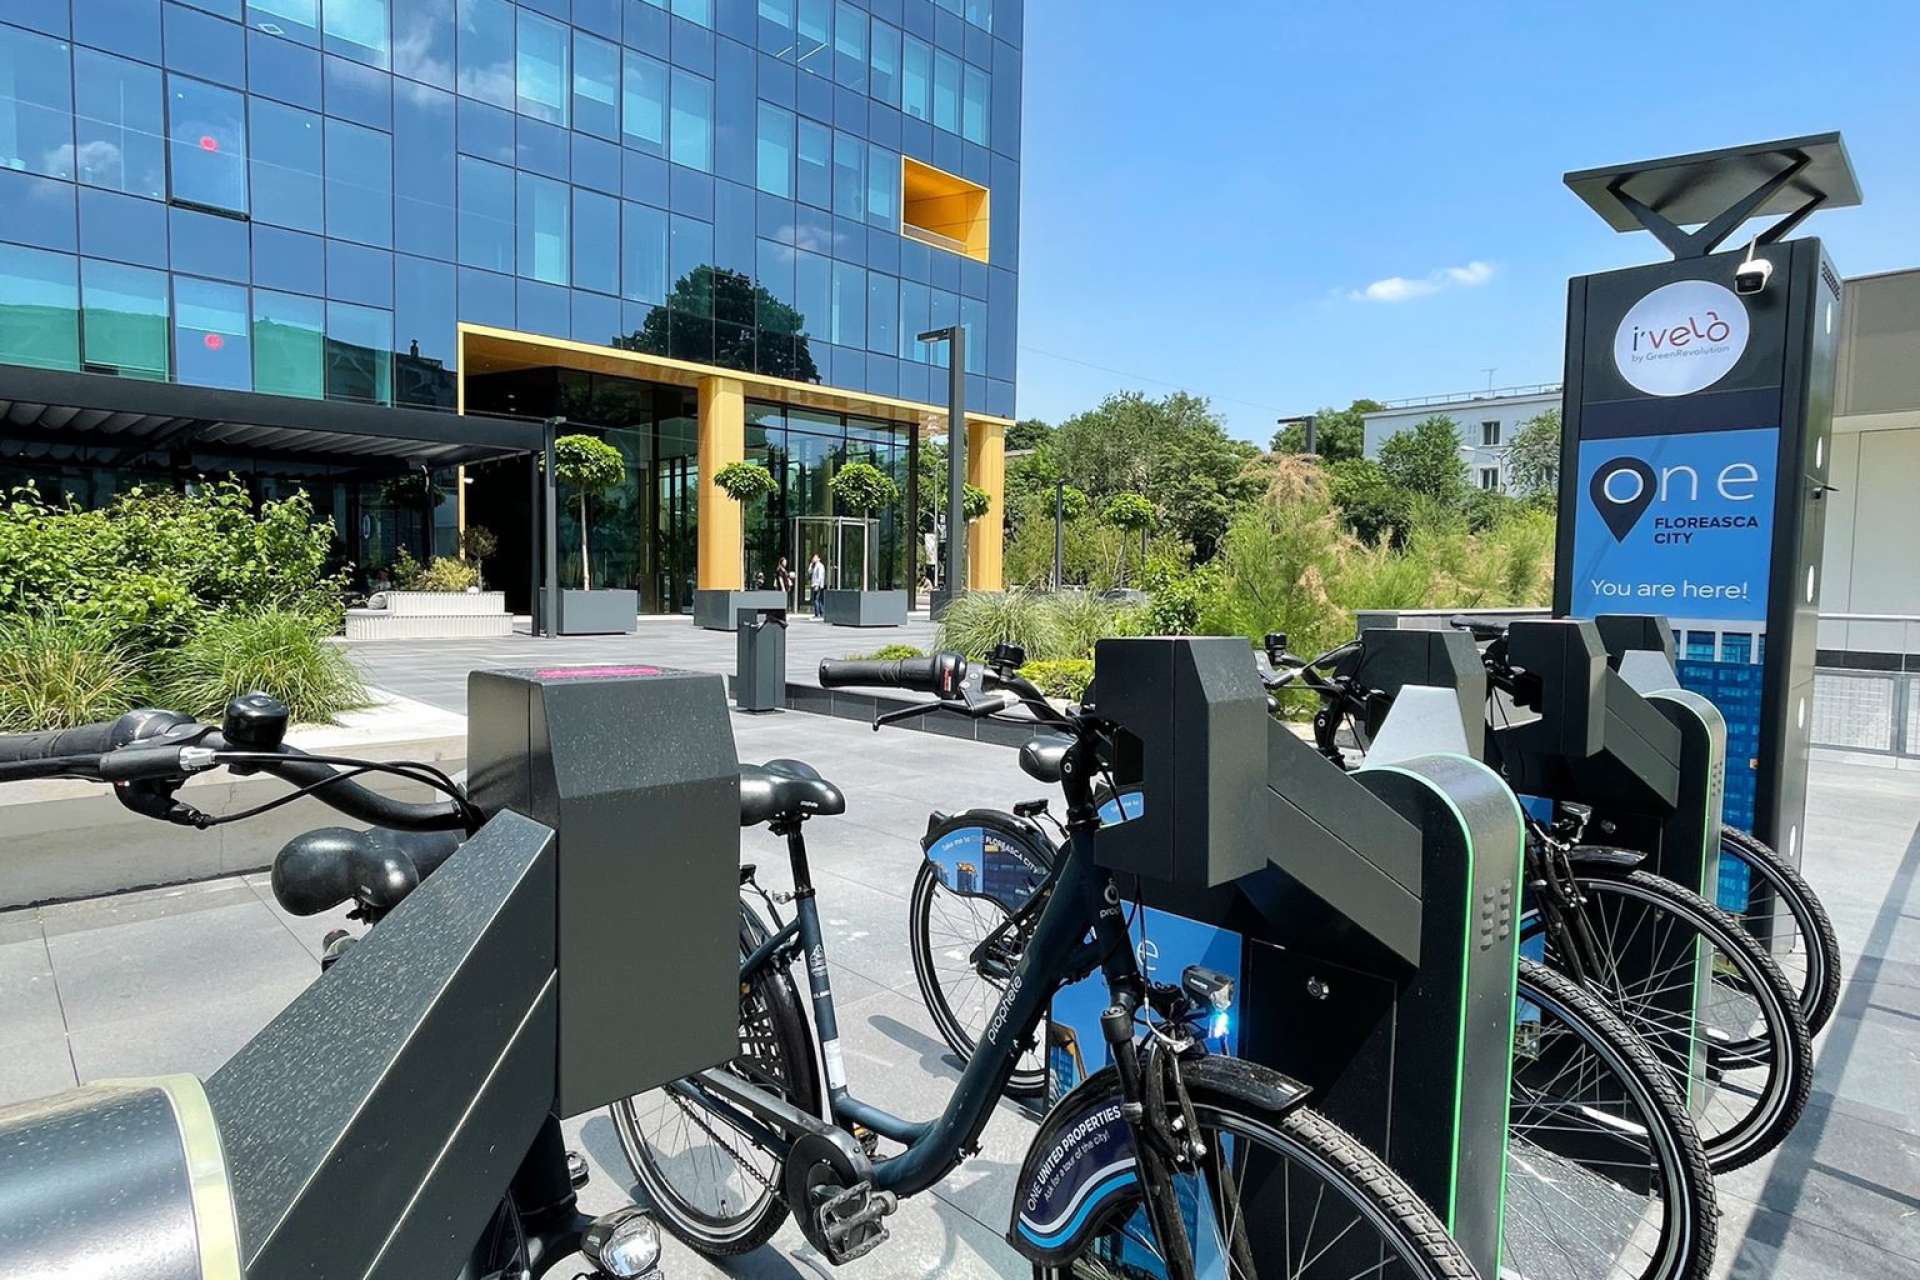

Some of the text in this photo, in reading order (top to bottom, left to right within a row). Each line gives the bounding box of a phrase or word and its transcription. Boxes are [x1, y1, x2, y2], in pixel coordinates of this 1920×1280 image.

[1632, 346, 1730, 363] by GreenRevolution
[1603, 462, 1759, 504] one
[1654, 516, 1759, 529] FLOREASCA
[1654, 532, 1694, 544] CITY
[1591, 579, 1748, 599] You are here!
[985, 836, 1023, 861] FLOREASCA
[1023, 857, 1038, 874] CITY
[988, 976, 1022, 1046] prophete
[1081, 1141, 1094, 1154] the
[1027, 1105, 1121, 1211] ONE UNITED PROPERTIES
